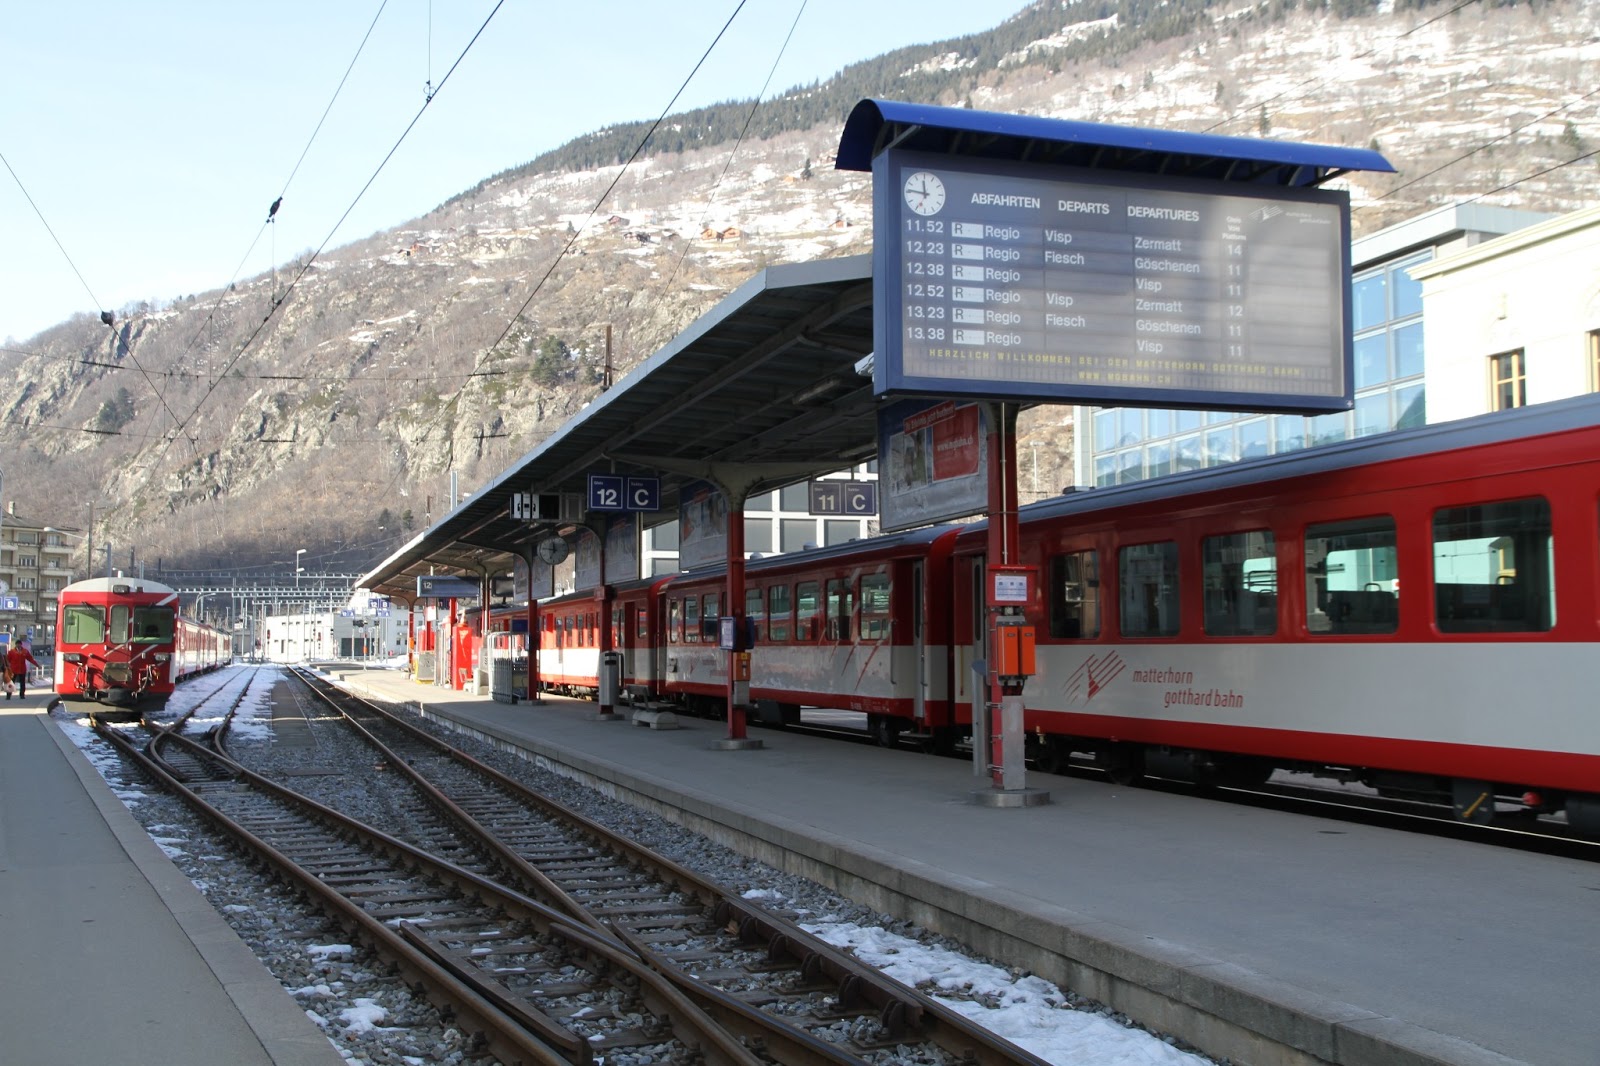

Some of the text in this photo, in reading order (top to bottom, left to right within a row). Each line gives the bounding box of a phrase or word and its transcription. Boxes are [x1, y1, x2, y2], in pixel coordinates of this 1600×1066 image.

[971, 192, 1199, 222] ABFAHRTEN DEPARTS DEPARTURES
[906, 219, 1242, 256] 11.52 R Regio Visp Zermatt 14
[906, 240, 1241, 276] 12.23 R Regio Fiesch Göschenen 11
[907, 262, 1241, 296] 12.38 R Regio Visp 11
[907, 284, 1243, 317] 12.52 R Regio Visp Zermatt 12
[907, 305, 1241, 337] 13.23 R Regio Fiesch Göschenen 11
[907, 327, 1242, 357] 13.38 R Regio Visp 11
[929, 349, 990, 360] HERZLICH
[997, 352, 1072, 364] WILLKOMMEN
[597, 488, 617, 506] 12
[634, 488, 649, 506] C
[818, 494, 835, 511] 11
[852, 494, 866, 511] C
[1132, 666, 1193, 684] matterhorn
[1164, 688, 1243, 708] gotthard bahn
